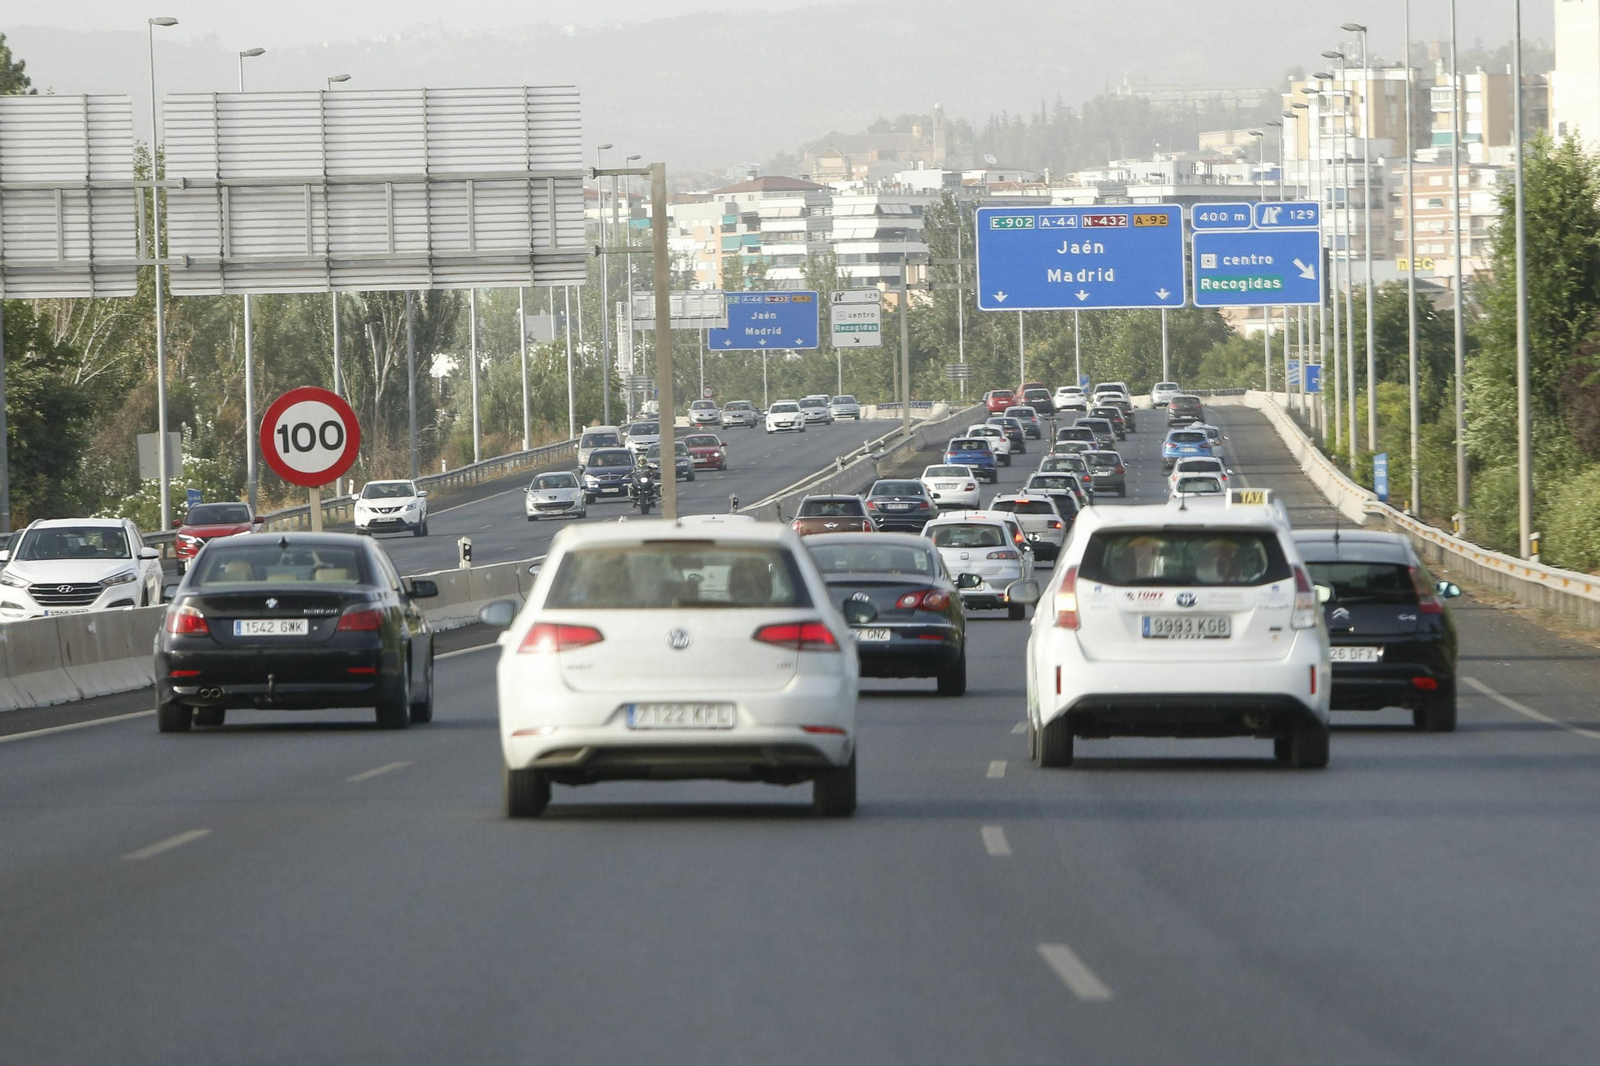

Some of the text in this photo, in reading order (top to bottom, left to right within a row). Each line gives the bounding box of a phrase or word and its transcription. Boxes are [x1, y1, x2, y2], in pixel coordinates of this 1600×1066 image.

[992, 214, 1167, 228] E-902 A-44 N-432 A-92
[1199, 212, 1246, 222] 400 m
[1290, 209, 1316, 220] 129
[1057, 239, 1104, 254] Jaén
[1223, 253, 1275, 266] centro
[1047, 268, 1115, 283] Madrid
[1200, 277, 1282, 293] Recogidas
[751, 311, 777, 320] Jaén
[745, 327, 782, 335] Madrid
[834, 323, 878, 333] Recogidas
[277, 420, 344, 454] 100
[1241, 491, 1266, 504] TAXI
[246, 621, 303, 634] 1542 GWK
[1154, 618, 1192, 633] 9993
[867, 630, 887, 639] GNZ
[1350, 648, 1374, 660] DFX
